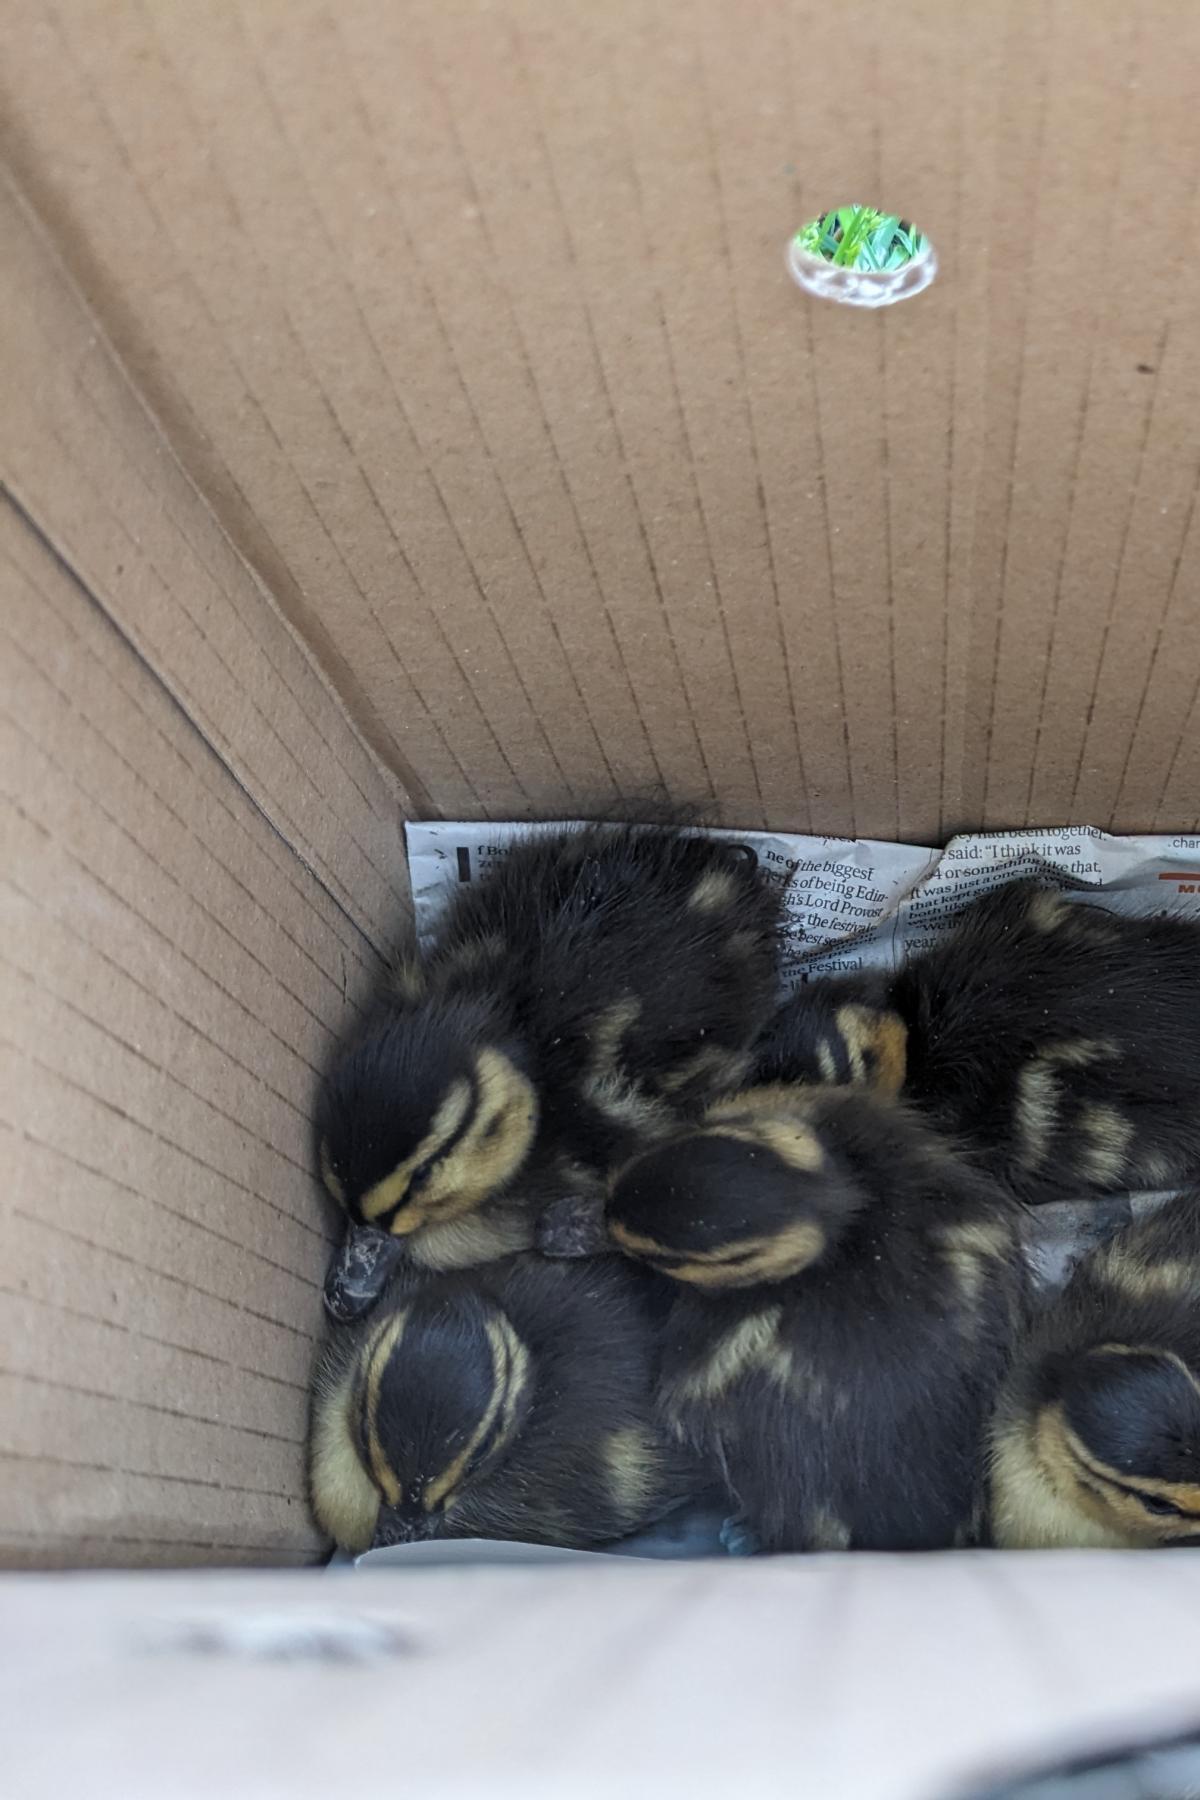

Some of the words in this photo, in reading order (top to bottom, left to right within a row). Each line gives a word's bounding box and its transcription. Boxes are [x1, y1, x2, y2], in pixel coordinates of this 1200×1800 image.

[948, 845, 983, 860] said:
[1001, 843, 1040, 859] think
[1042, 844, 1054, 857] it
[1054, 845, 1081, 856] was
[802, 861, 822, 872] the
[823, 860, 875, 881] biggest
[945, 869, 961, 879] or
[1071, 860, 1102, 875] that.
[799, 876, 817, 889] of
[815, 878, 855, 899] being
[856, 885, 889, 902] Edin-
[923, 884, 952, 897] was
[952, 878, 981, 893] just
[982, 876, 991, 884] a
[805, 894, 840, 912] Lord
[840, 901, 884, 917] Provost
[910, 899, 940, 911] that
[941, 891, 973, 904] kept
[807, 913, 830, 928] the
[909, 907, 940, 919] both
[808, 956, 863, 973] Festival
